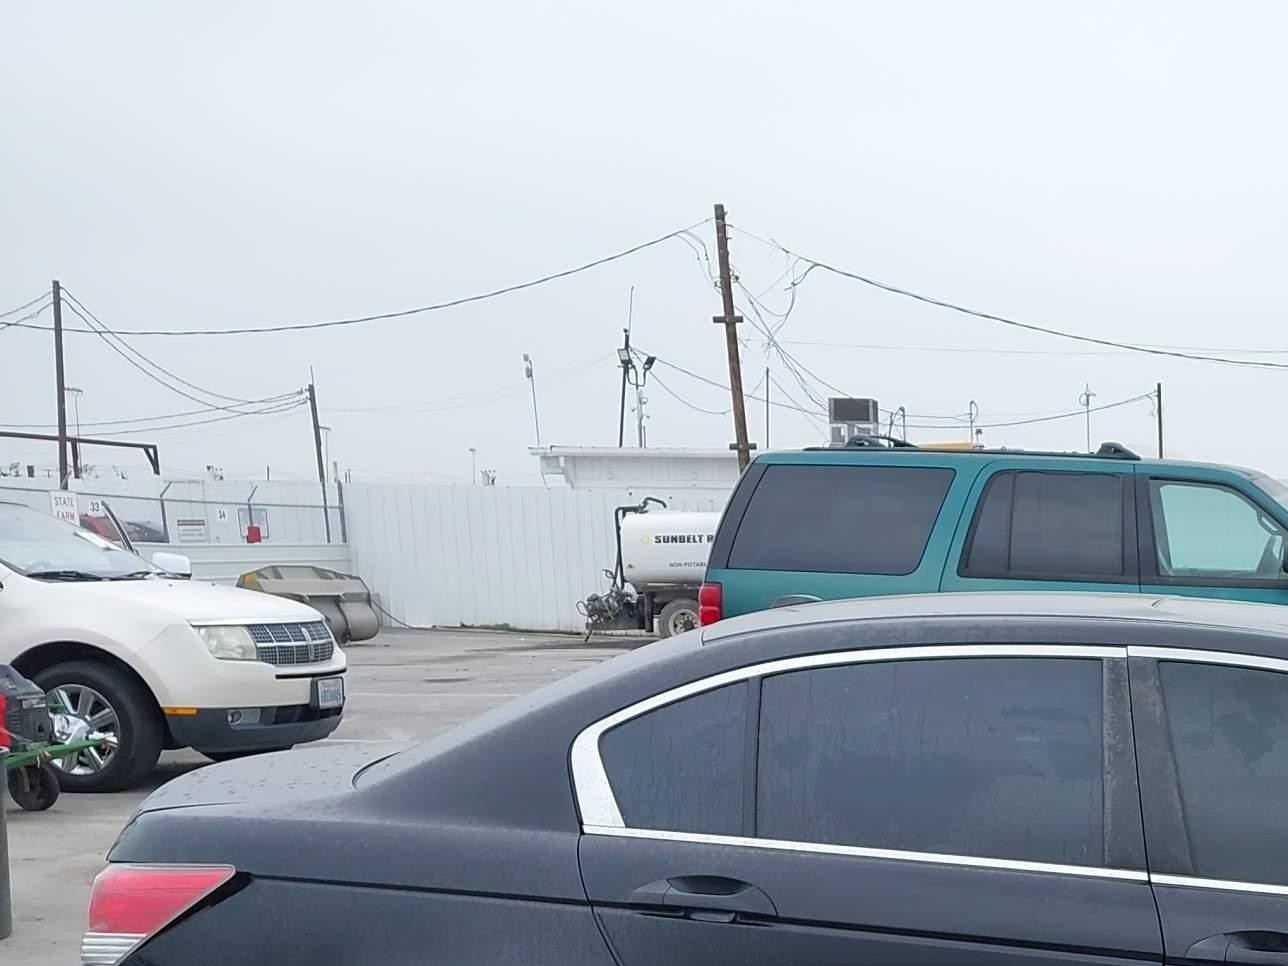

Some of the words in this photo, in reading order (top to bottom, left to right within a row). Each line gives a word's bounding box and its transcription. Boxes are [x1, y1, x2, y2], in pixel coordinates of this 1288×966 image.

[54, 496, 75, 507] STATE
[90, 502, 100, 512] 33
[56, 511, 75, 521] FARM
[654, 534, 704, 544] SUNBELT
